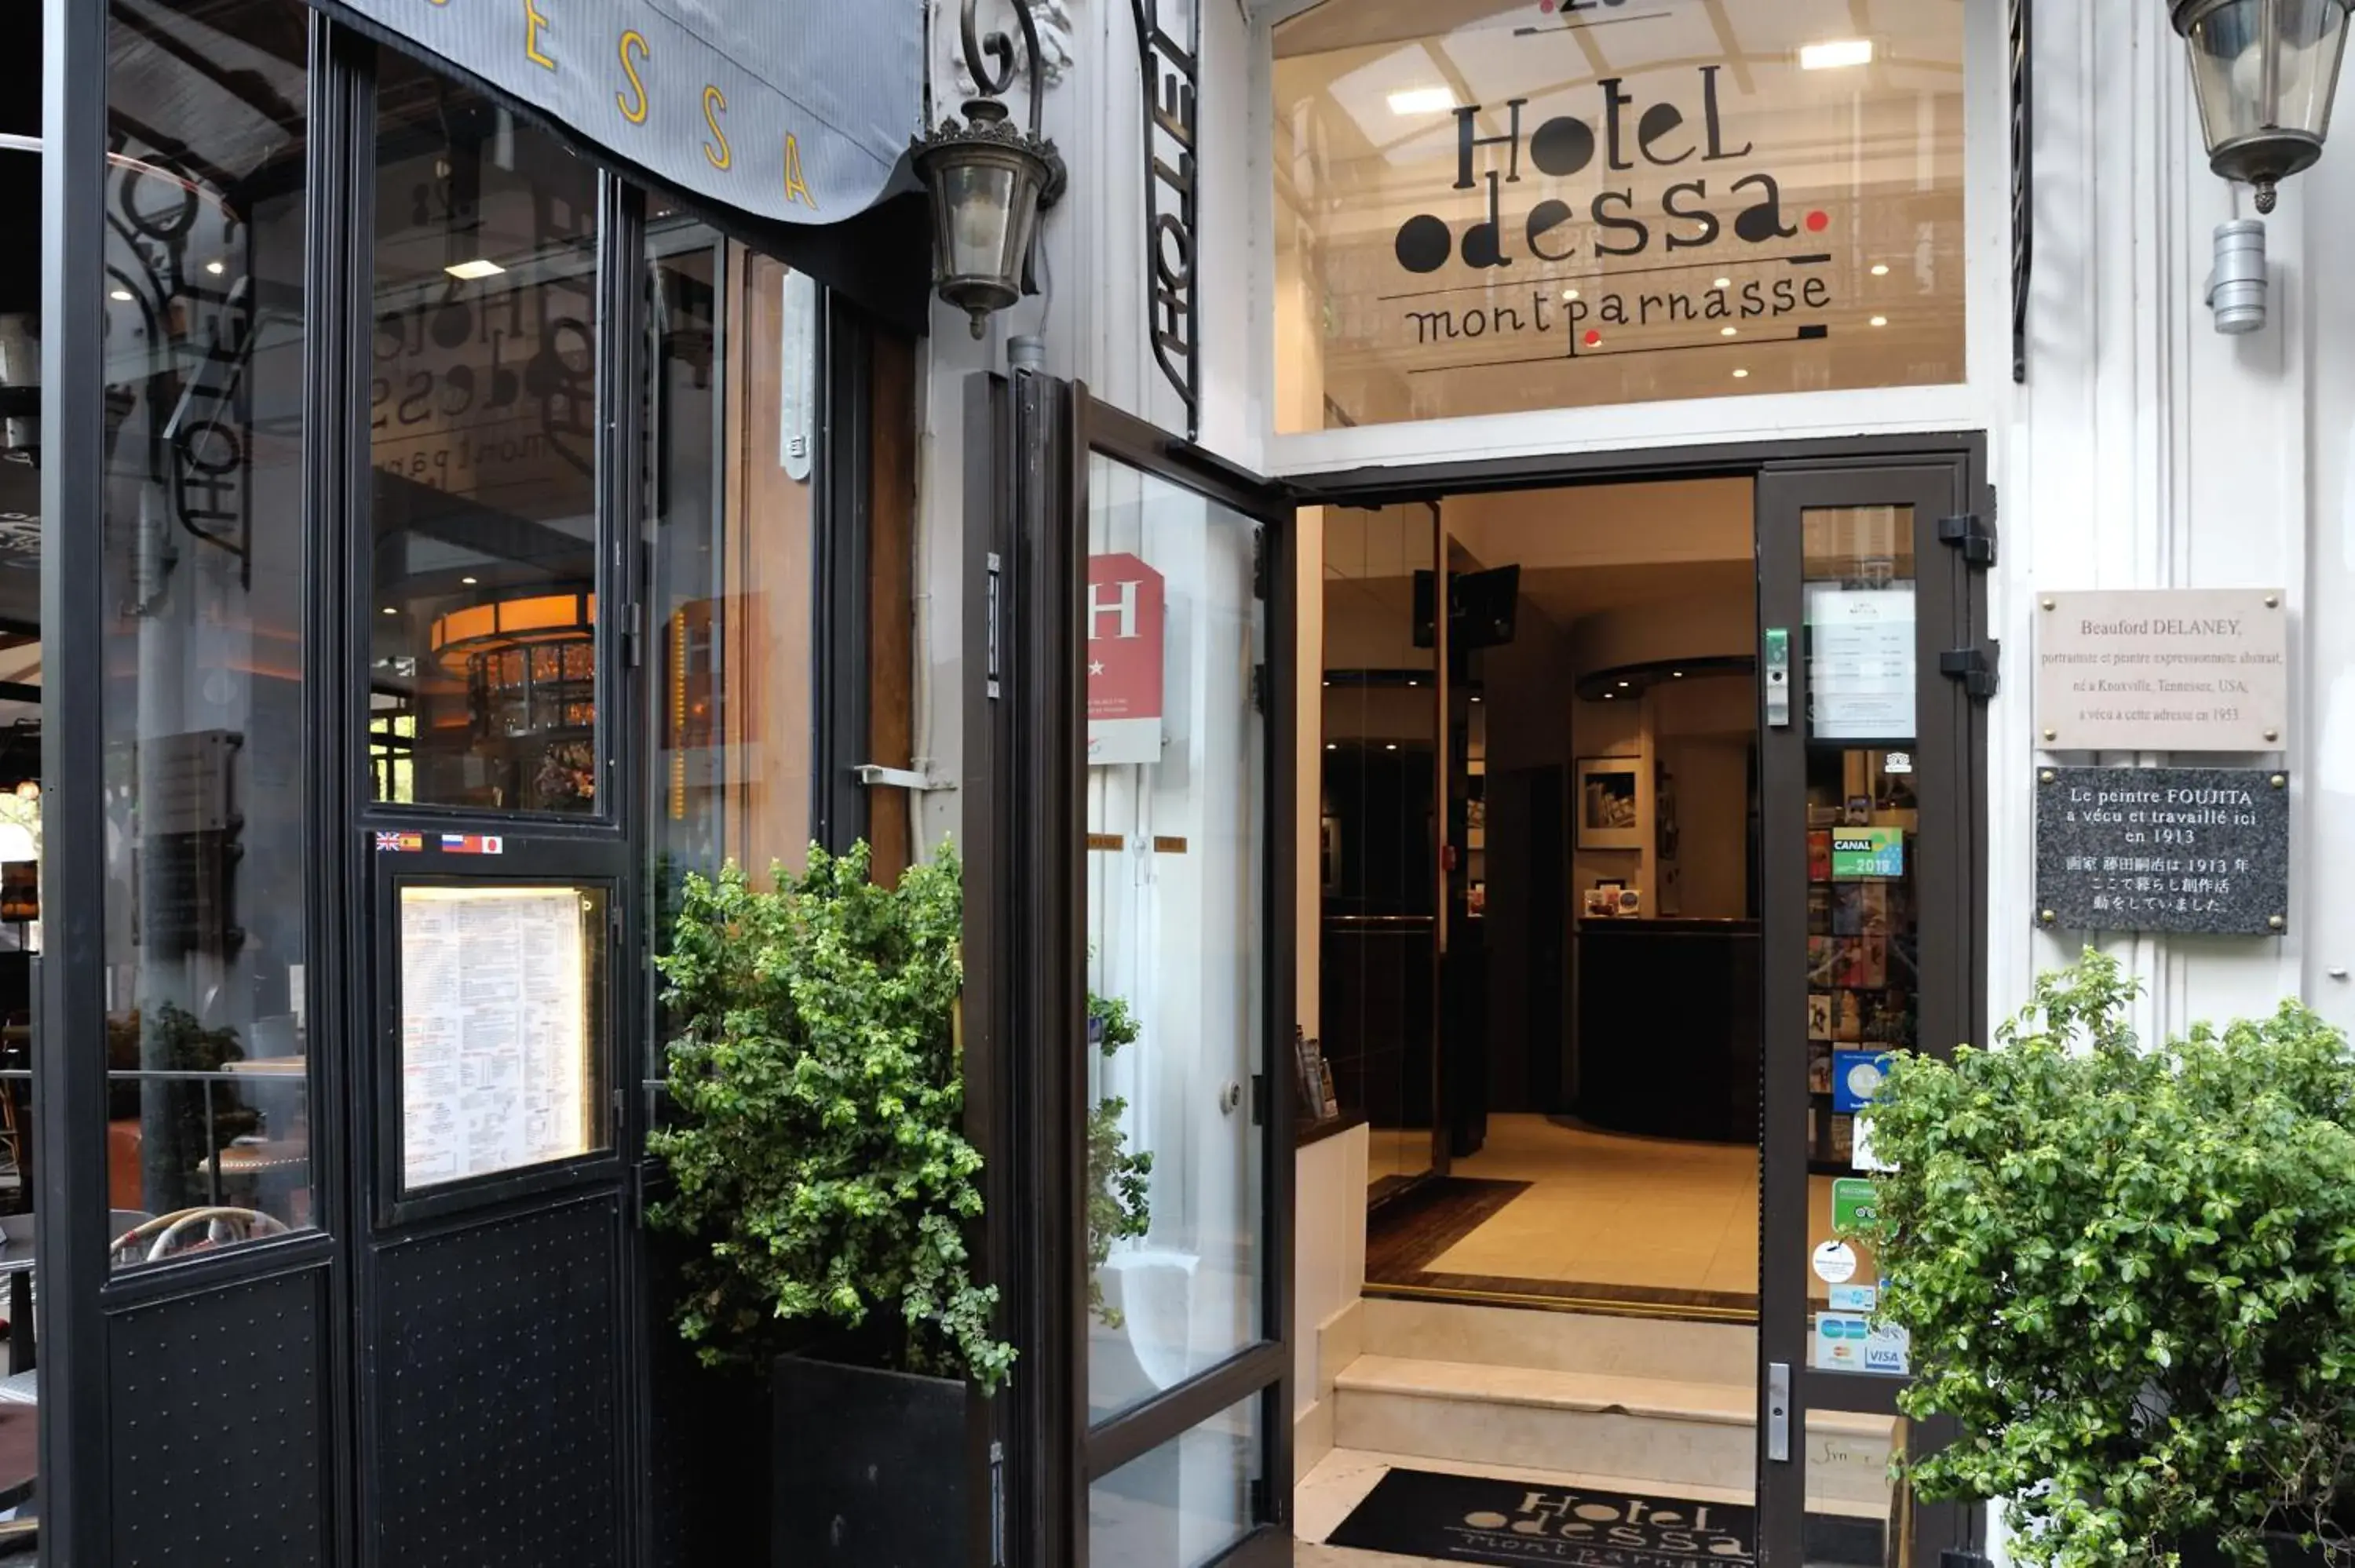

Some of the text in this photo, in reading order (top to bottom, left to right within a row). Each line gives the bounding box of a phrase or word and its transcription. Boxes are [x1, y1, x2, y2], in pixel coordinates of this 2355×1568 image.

[424, 0, 818, 212] ESSA
[1405, 275, 1831, 358] montparnasse
[2080, 618, 2243, 636] Beauford DELANEY,
[2070, 788, 2253, 806] Le peintre FOUJITA
[2066, 809, 2255, 825] a vécu et travaillé ici
[2125, 829, 2195, 844] en 1913
[1834, 841, 1870, 850] CANAL
[2189, 858, 2228, 873] 1913
[1871, 1350, 1899, 1362] VISA
